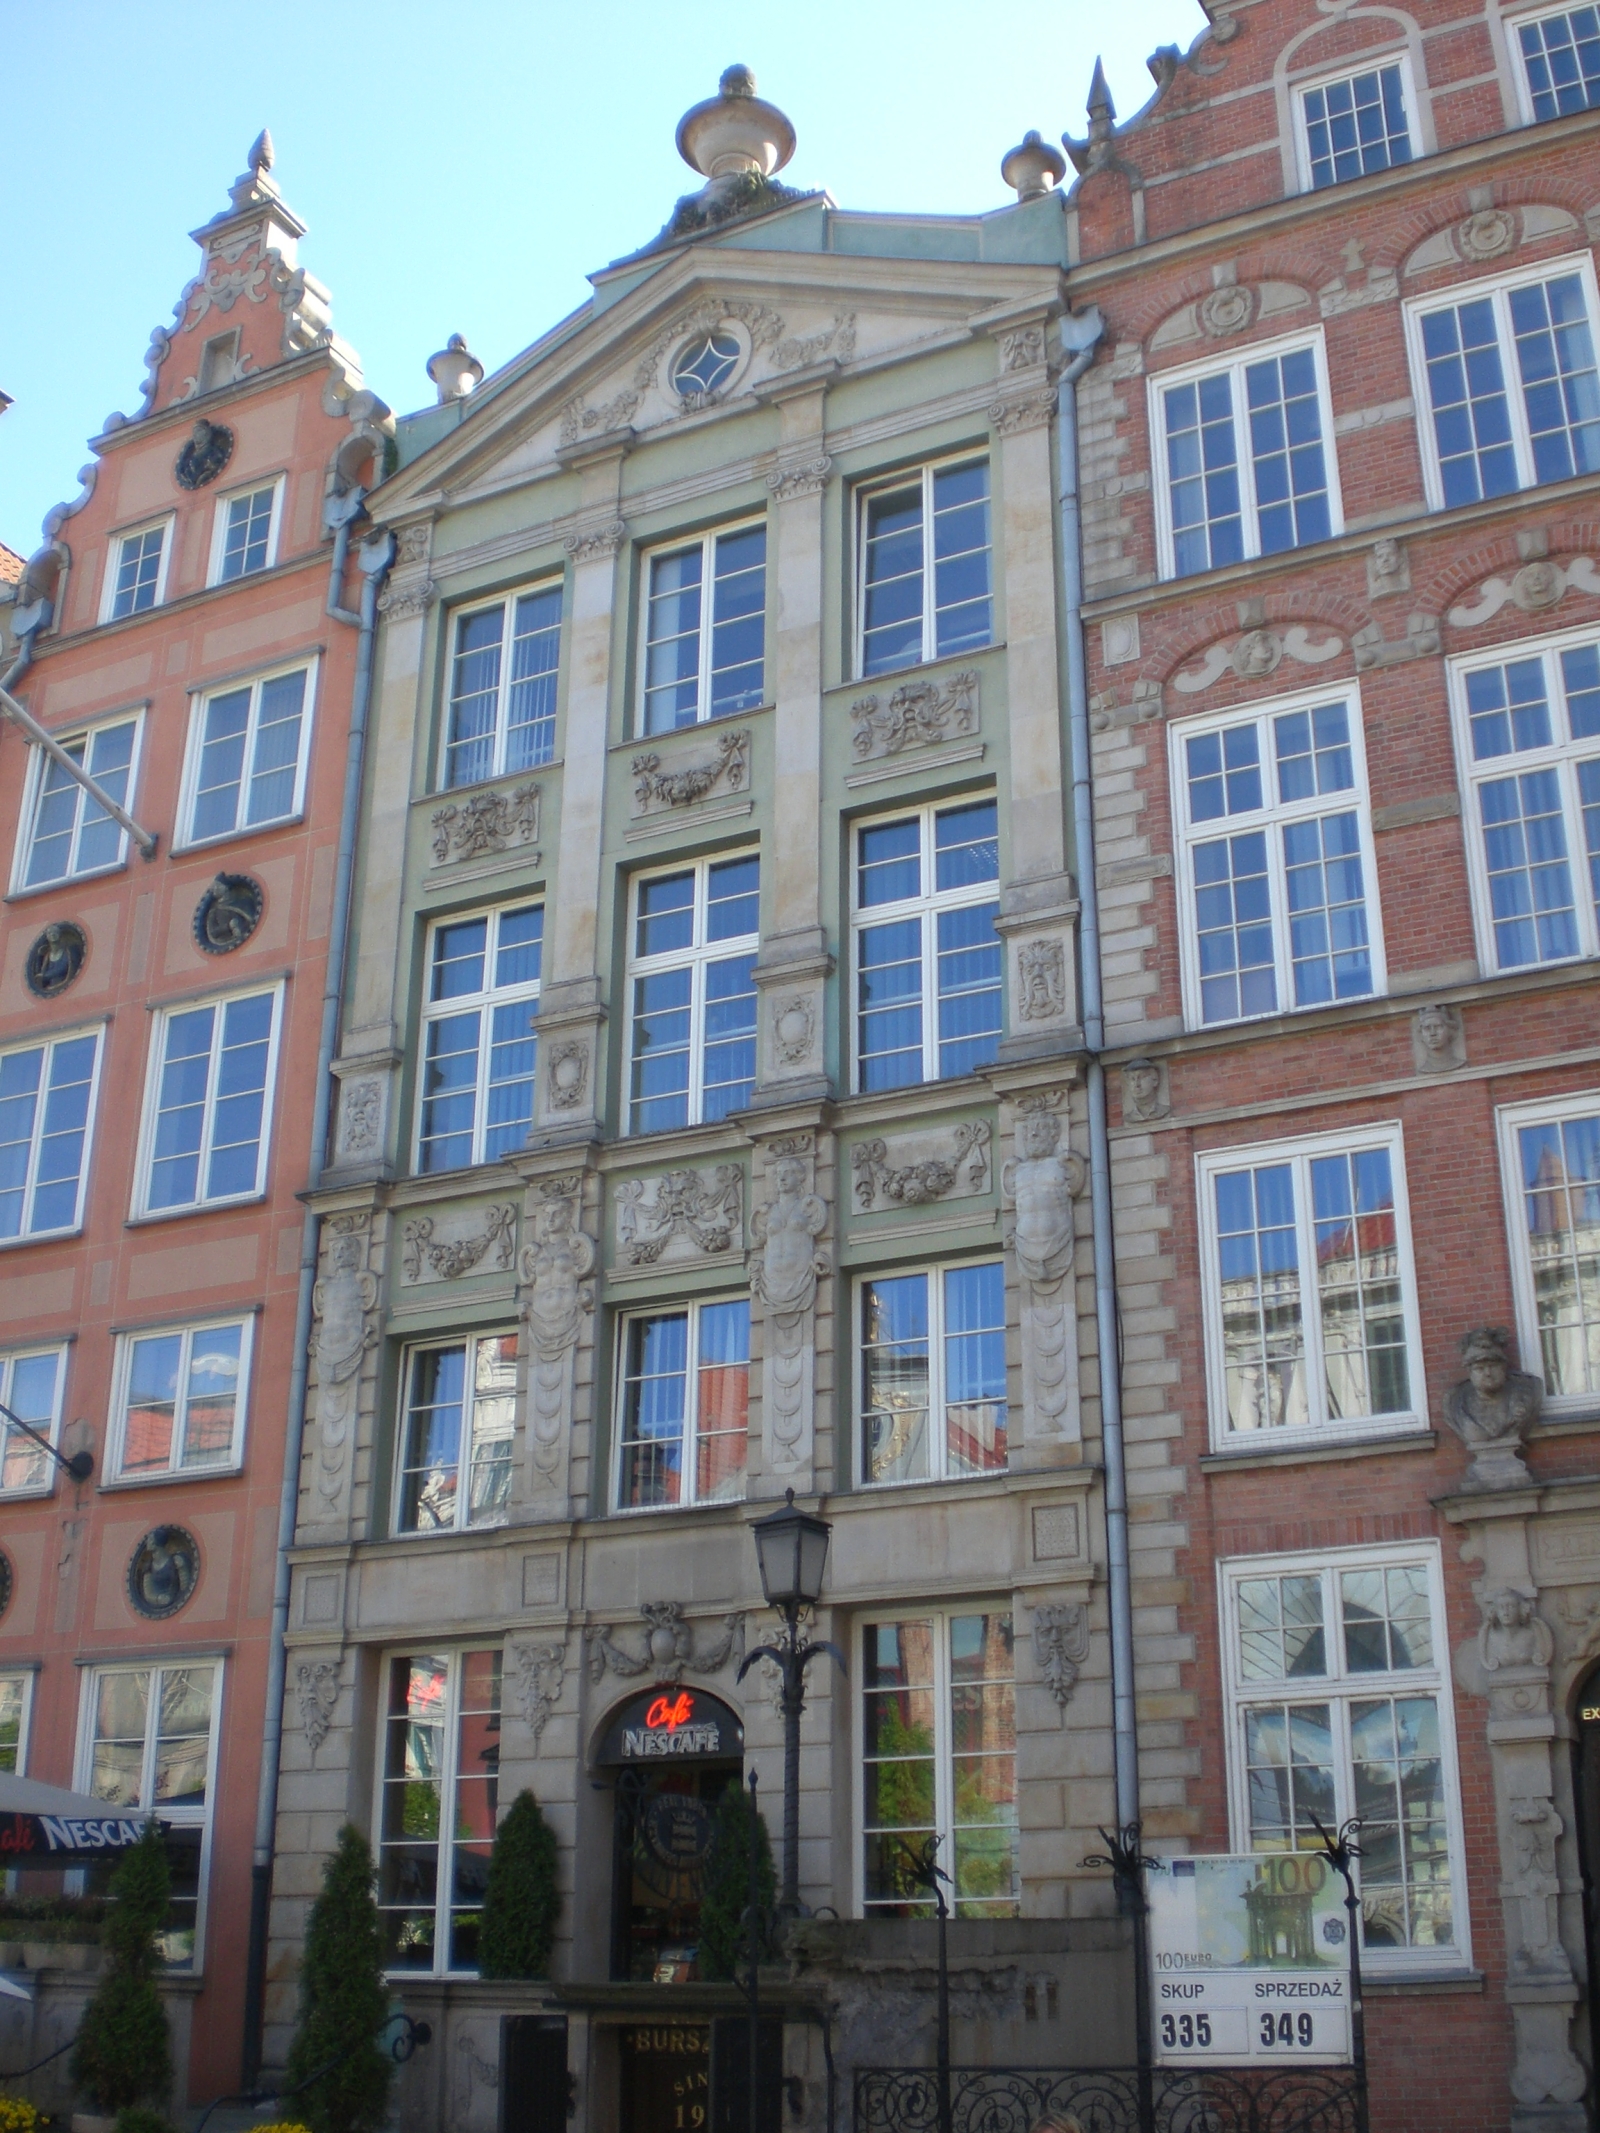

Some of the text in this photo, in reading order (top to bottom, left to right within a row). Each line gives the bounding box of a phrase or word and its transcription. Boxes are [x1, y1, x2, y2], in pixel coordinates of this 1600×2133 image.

[646, 1691, 694, 1732] Café
[1263, 1856, 1327, 1894] 100
[1156, 1952, 1212, 1971] 100 EURO
[1161, 1978, 1343, 1998] SKUP SPRZEDAŻ
[1161, 2012, 1313, 2048] 335 349
